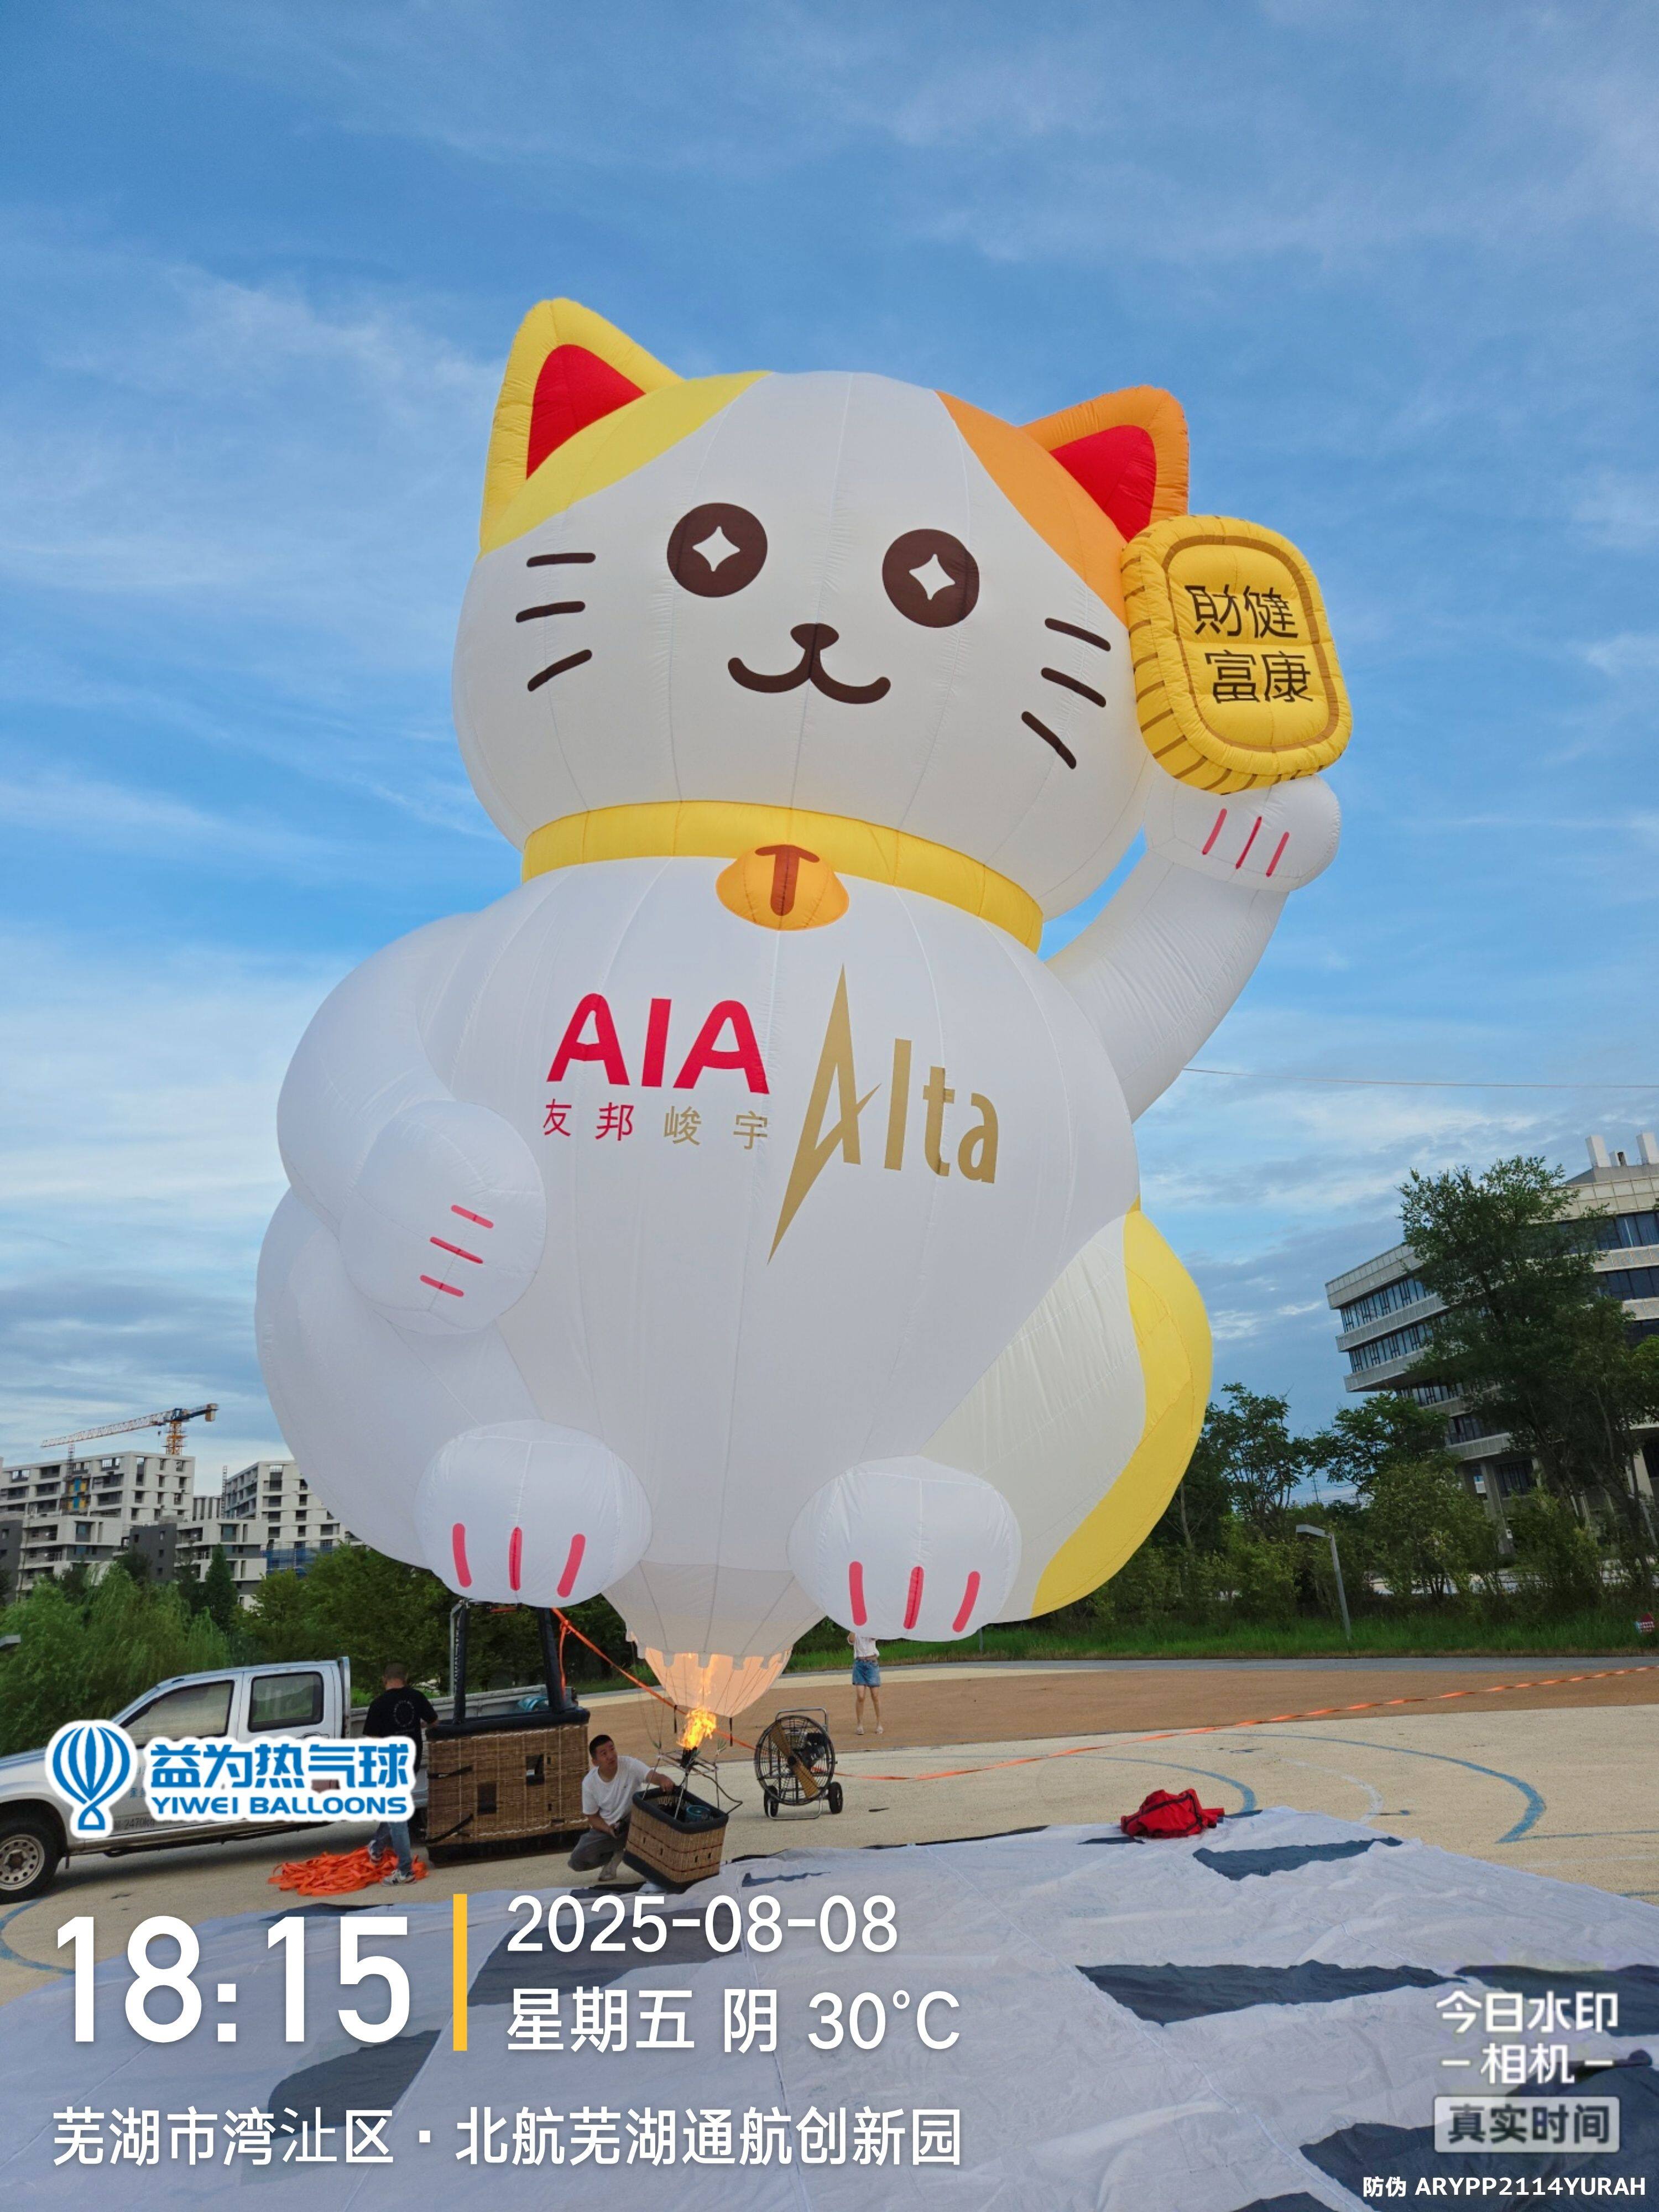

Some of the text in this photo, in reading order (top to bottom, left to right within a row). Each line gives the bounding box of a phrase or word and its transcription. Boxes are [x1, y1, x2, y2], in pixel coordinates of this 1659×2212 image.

[1184, 584, 1299, 638] 財健
[1204, 649, 1313, 704] 富康
[546, 993, 770, 1094] AIA
[543, 1098, 769, 1150] 友邦峻宇
[767, 963, 999, 1265] Alta
